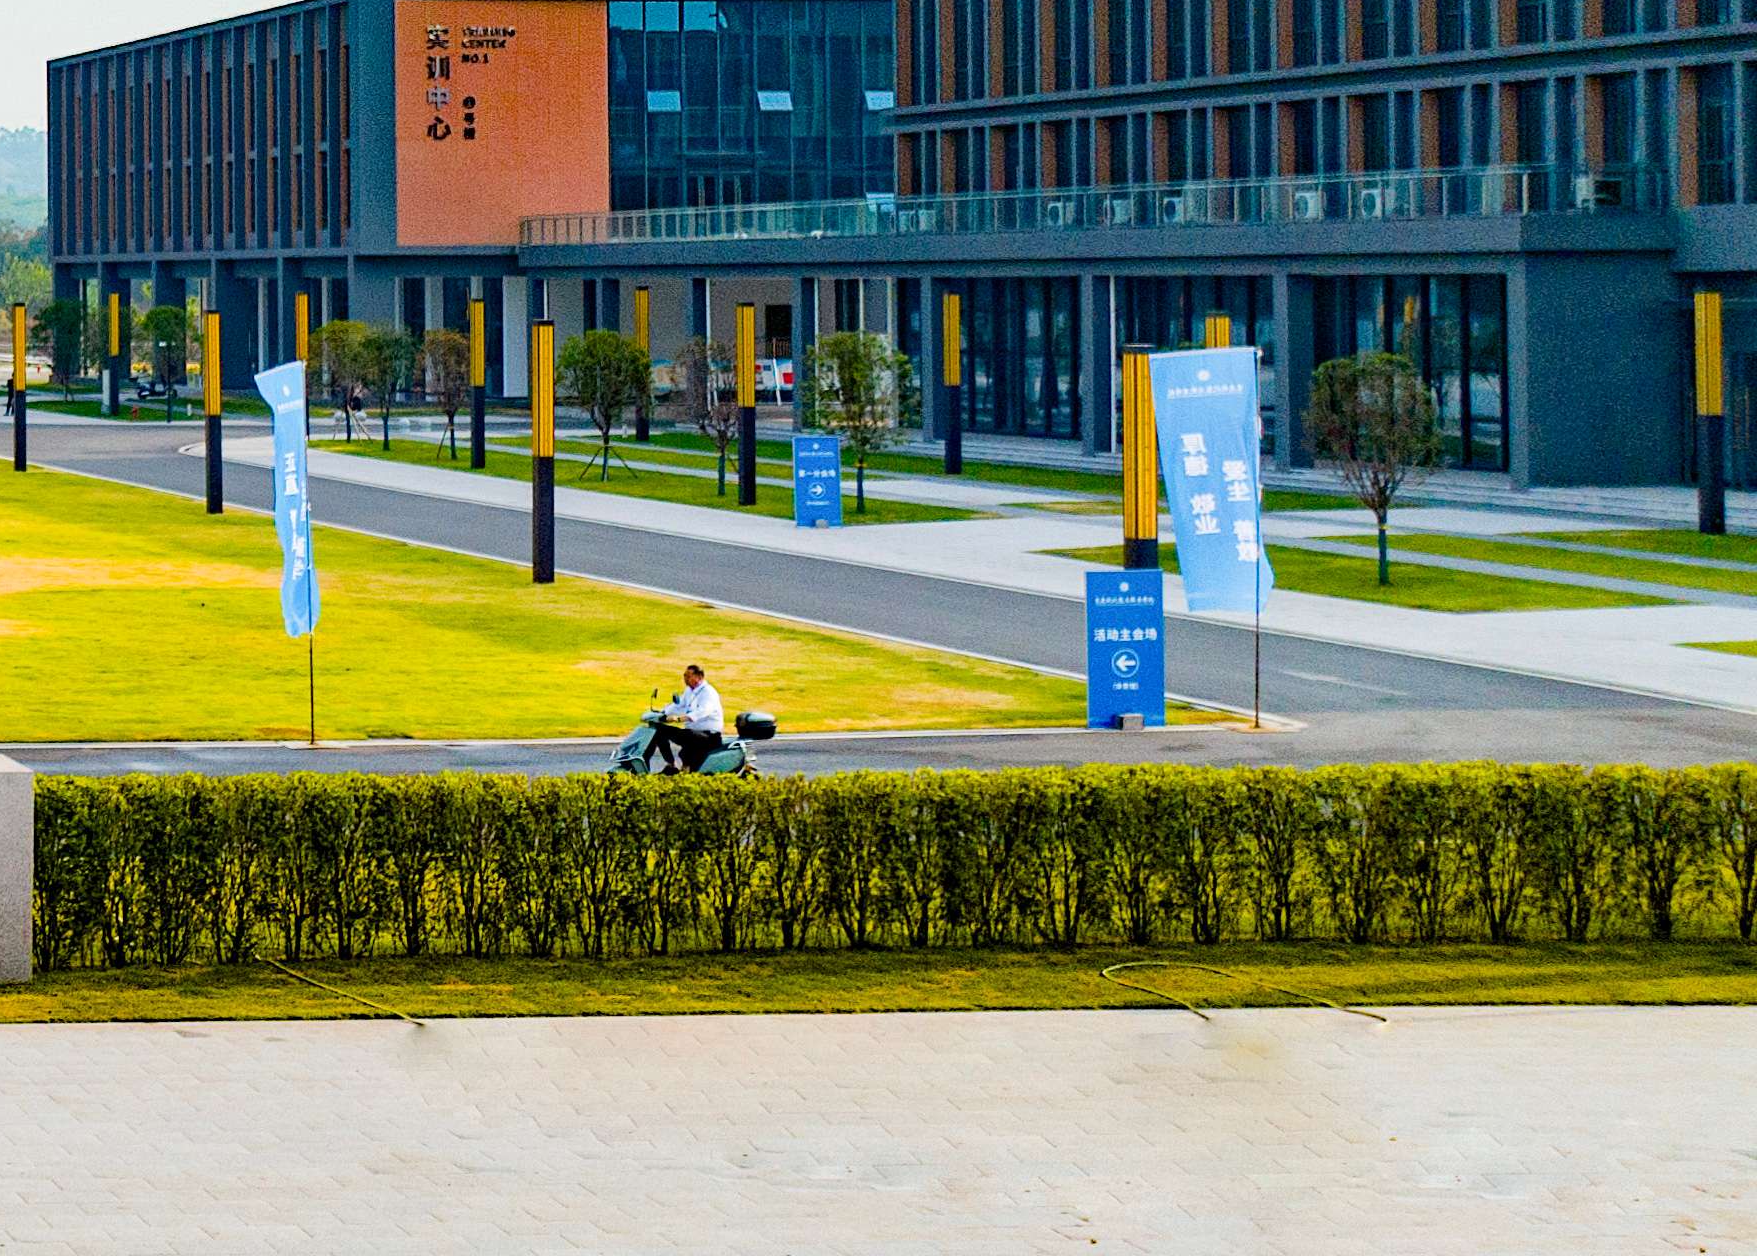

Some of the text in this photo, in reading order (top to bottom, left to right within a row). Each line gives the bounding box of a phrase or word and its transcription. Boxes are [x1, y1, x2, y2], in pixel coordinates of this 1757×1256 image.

[461, 39, 507, 49] CENTER
[426, 25, 451, 140] 实训中心
[1093, 627, 1158, 642] 活动主会场
